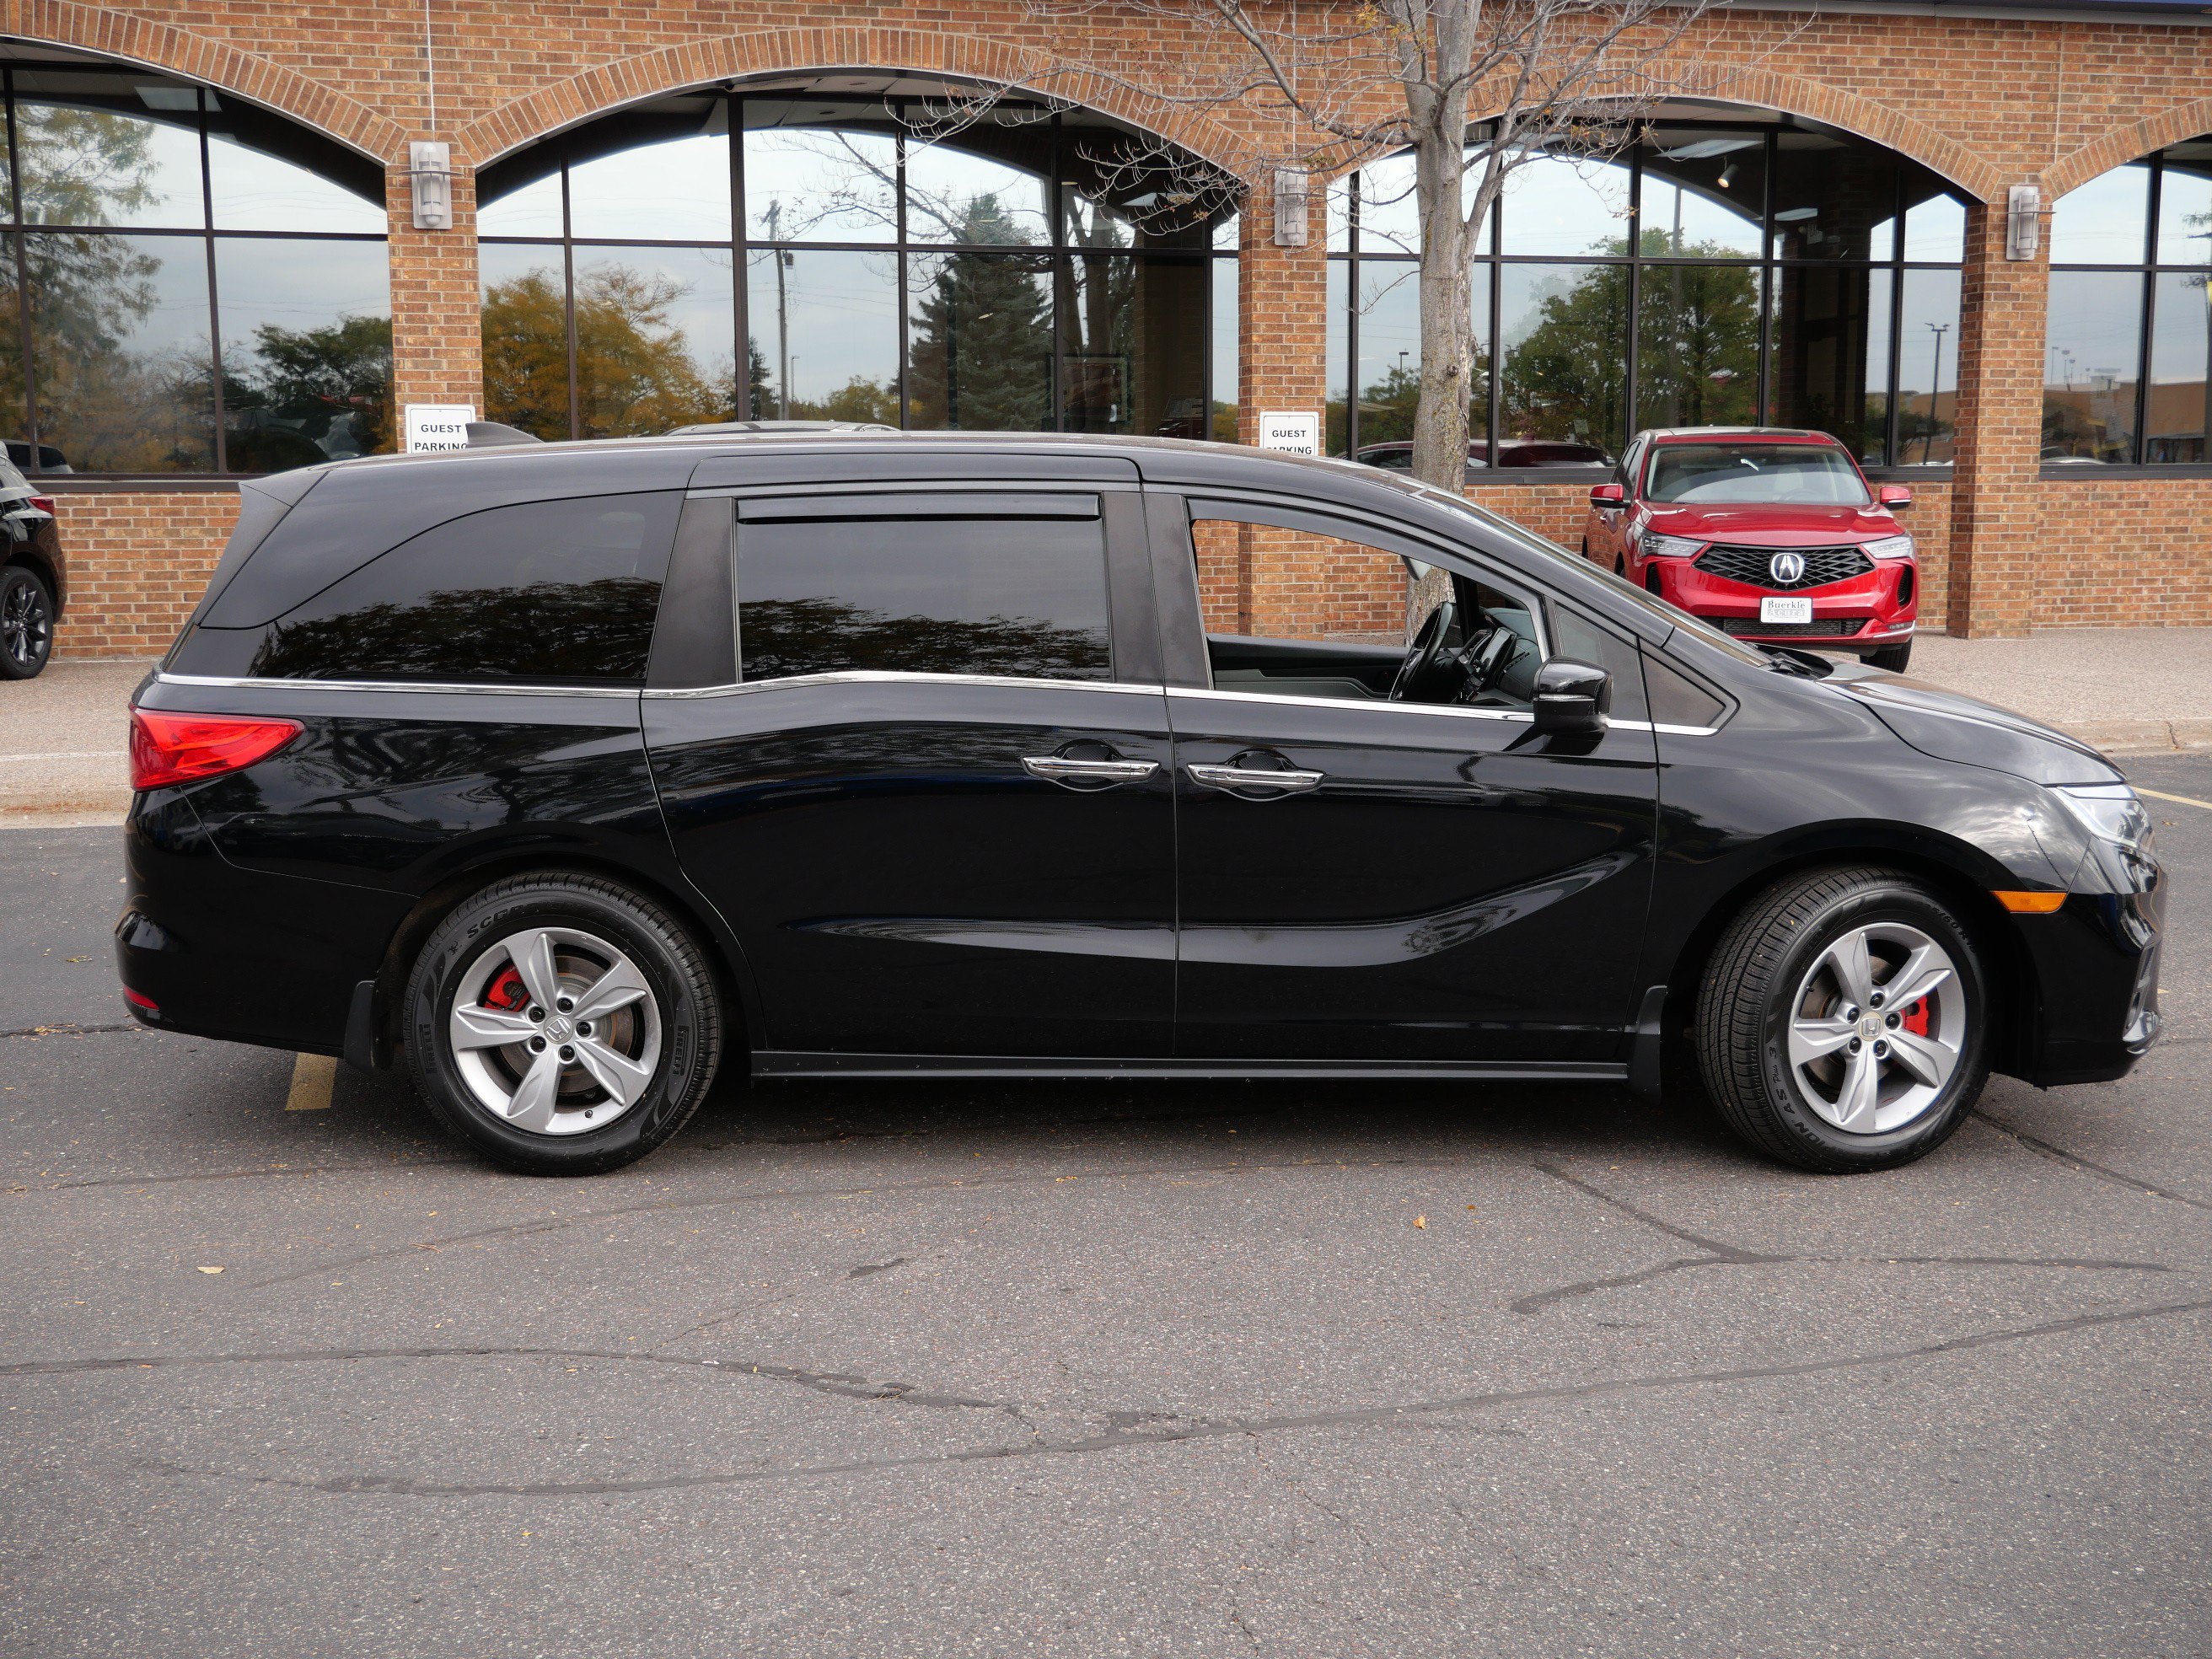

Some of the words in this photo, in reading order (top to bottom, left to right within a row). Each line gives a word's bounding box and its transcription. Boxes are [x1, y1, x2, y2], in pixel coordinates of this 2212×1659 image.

[421, 424, 462, 433] GUEST
[1267, 446, 1313, 455] RKING
[1768, 600, 1806, 609] Buerkle
[1768, 609, 1806, 617] Acura
